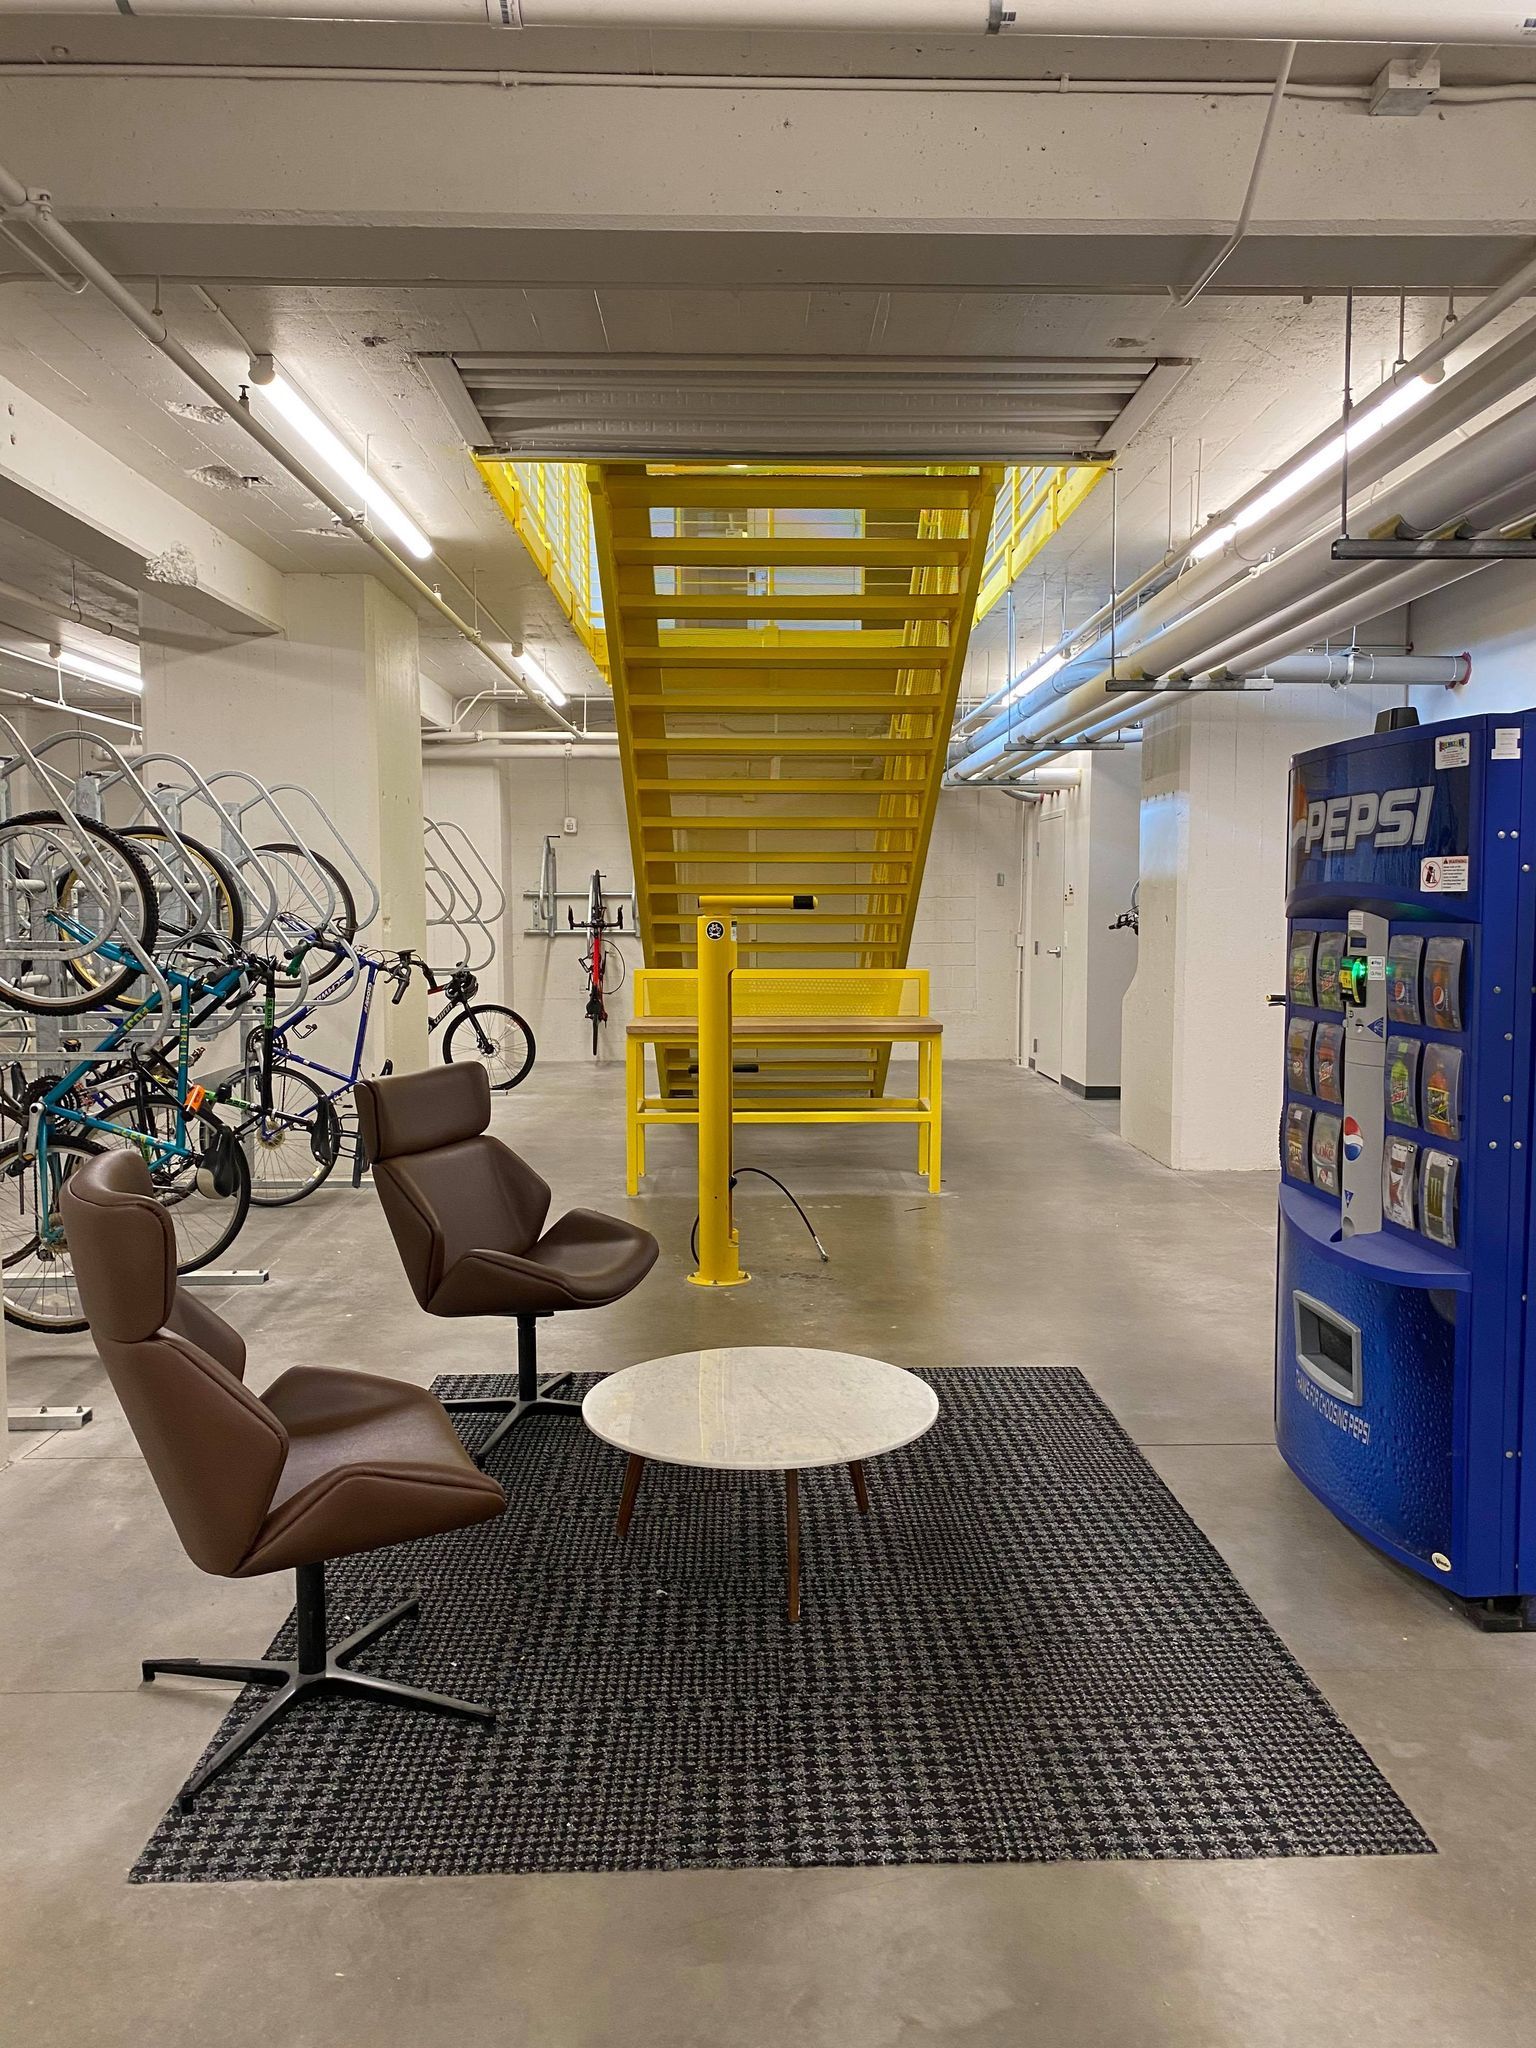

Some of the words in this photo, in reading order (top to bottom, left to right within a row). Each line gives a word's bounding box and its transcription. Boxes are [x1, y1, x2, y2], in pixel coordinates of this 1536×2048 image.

[1305, 786, 1435, 853] PEPSI
[123, 1006, 149, 1031] FUJI
[179, 1014, 188, 1065] THRILL
[1318, 1392, 1349, 1432] CHOOSING
[1347, 1413, 1371, 1446] PEPSI
